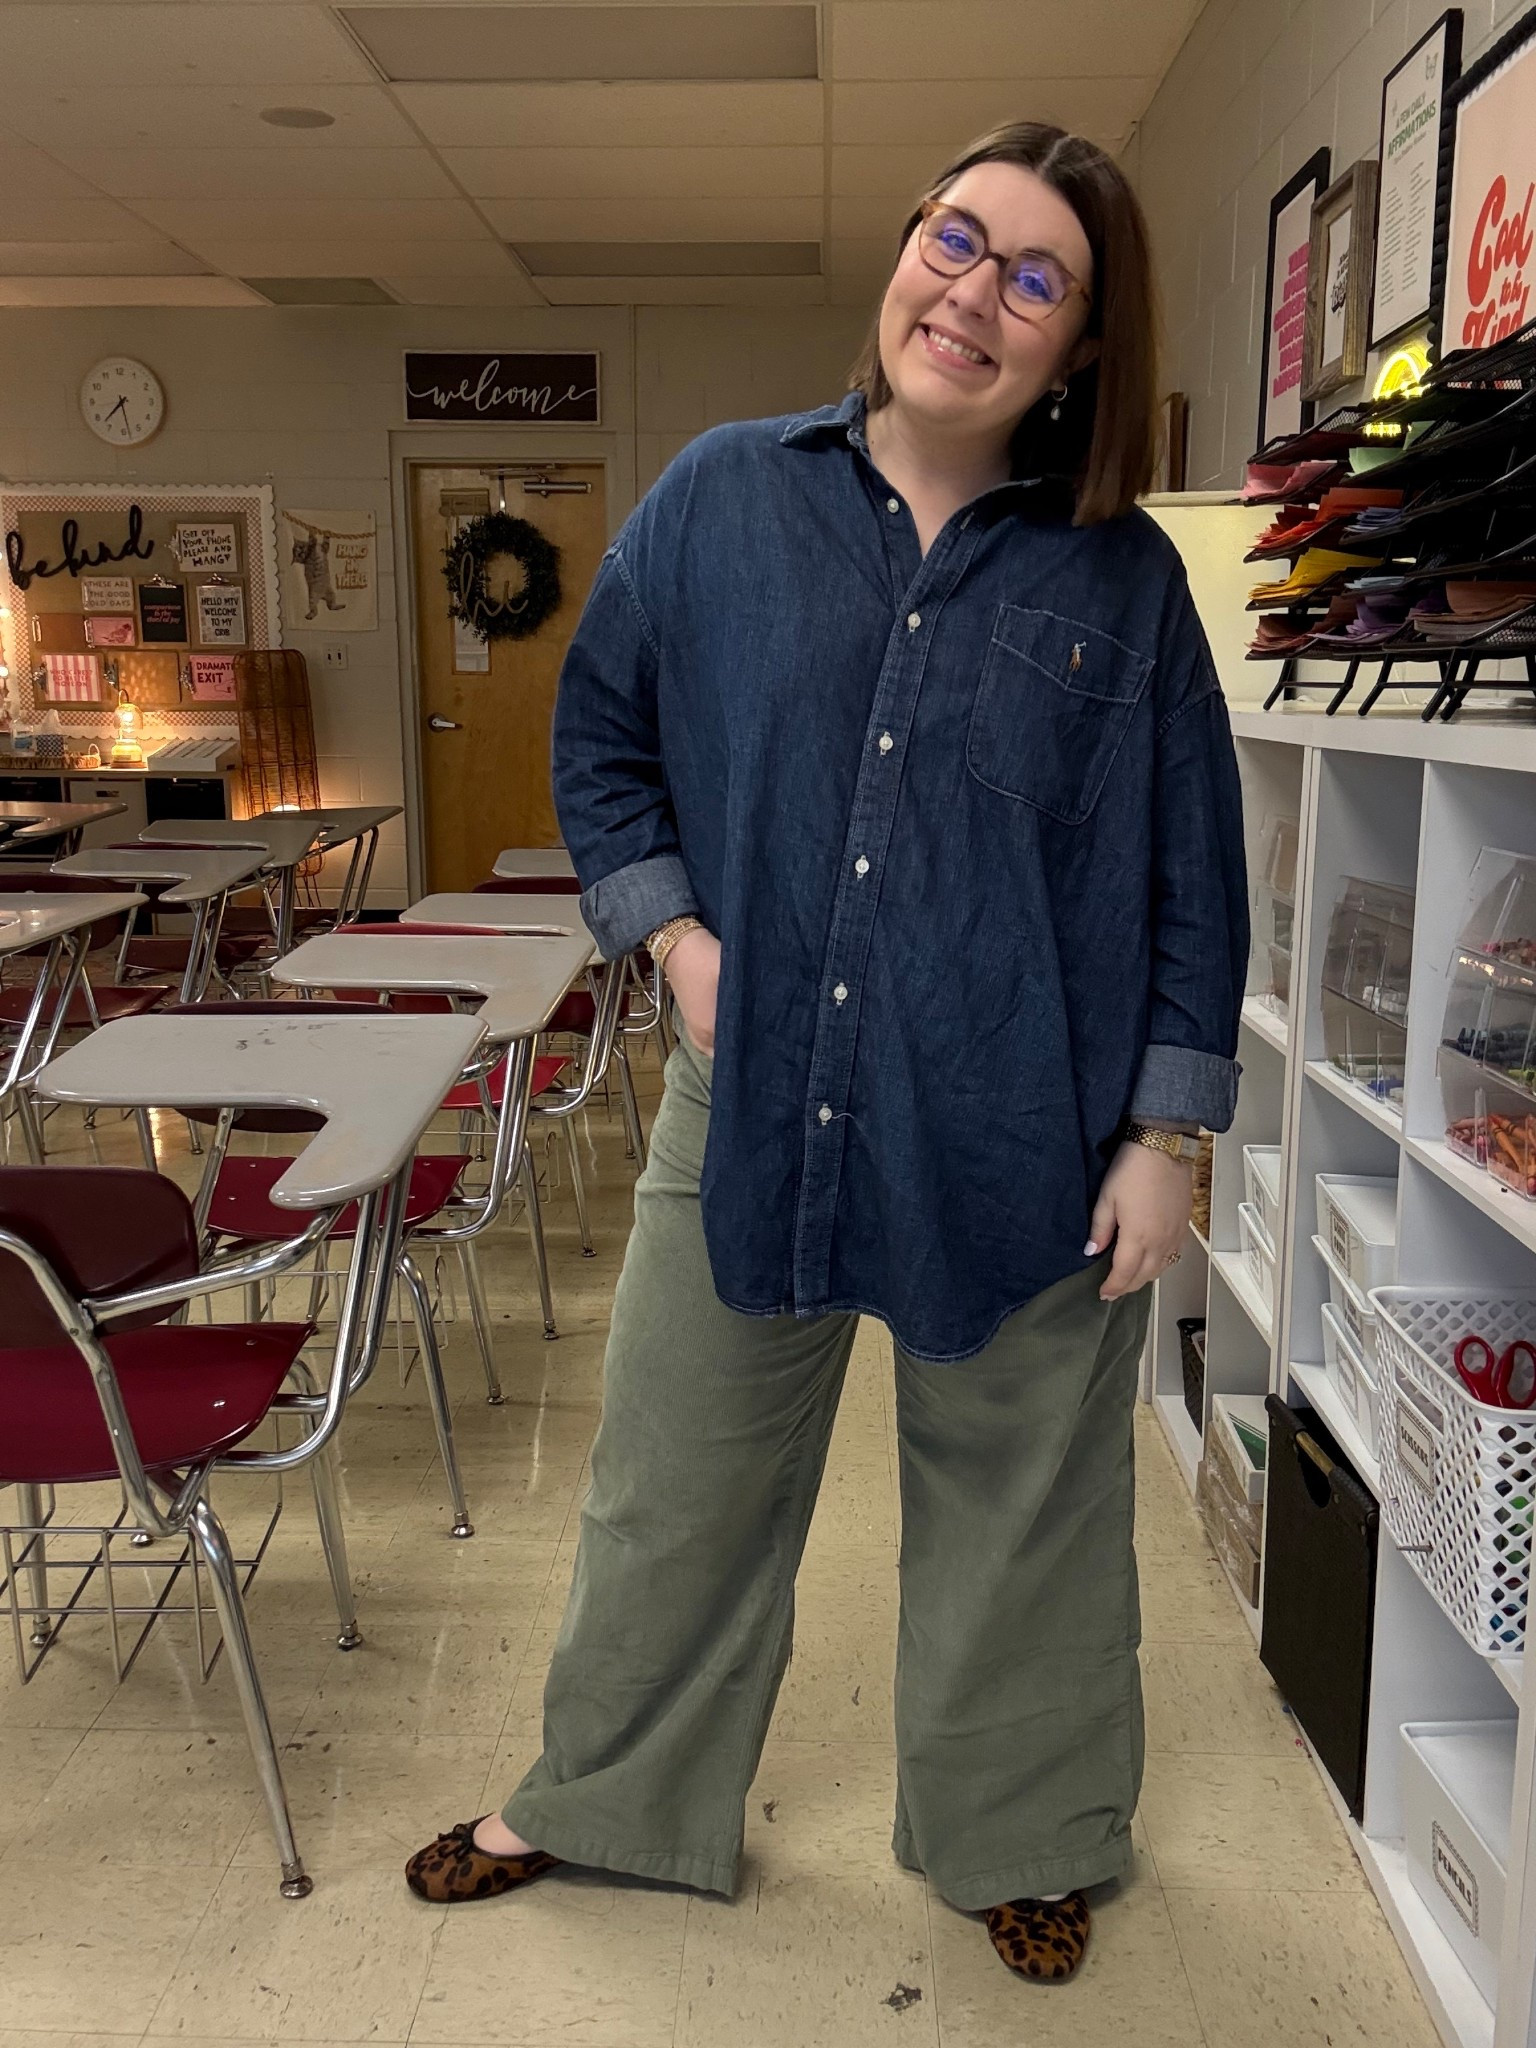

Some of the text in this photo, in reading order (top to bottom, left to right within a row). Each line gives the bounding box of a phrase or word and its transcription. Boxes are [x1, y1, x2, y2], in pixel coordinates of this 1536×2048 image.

[1388, 99, 1437, 160] AFFIRMATIONS
[1467, 174, 1535, 308] Cool
[1500, 276, 1511, 308] to
[406, 359, 597, 415] welcome
[183, 530, 198, 538] GET
[183, 535, 232, 548] YOUR PHONE
[184, 545, 232, 557] PLEASE AND
[335, 543, 369, 559] HANG
[192, 554, 225, 567] HANG
[114, 580, 130, 588] ARE
[201, 597, 222, 606] HELLO
[204, 608, 237, 616] WELCOME
[211, 618, 233, 626] TO MY
[197, 672, 224, 684] EXIT
[1400, 1425, 1429, 1468] SCISSORS
[1438, 1846, 1472, 1908] PENCILS
